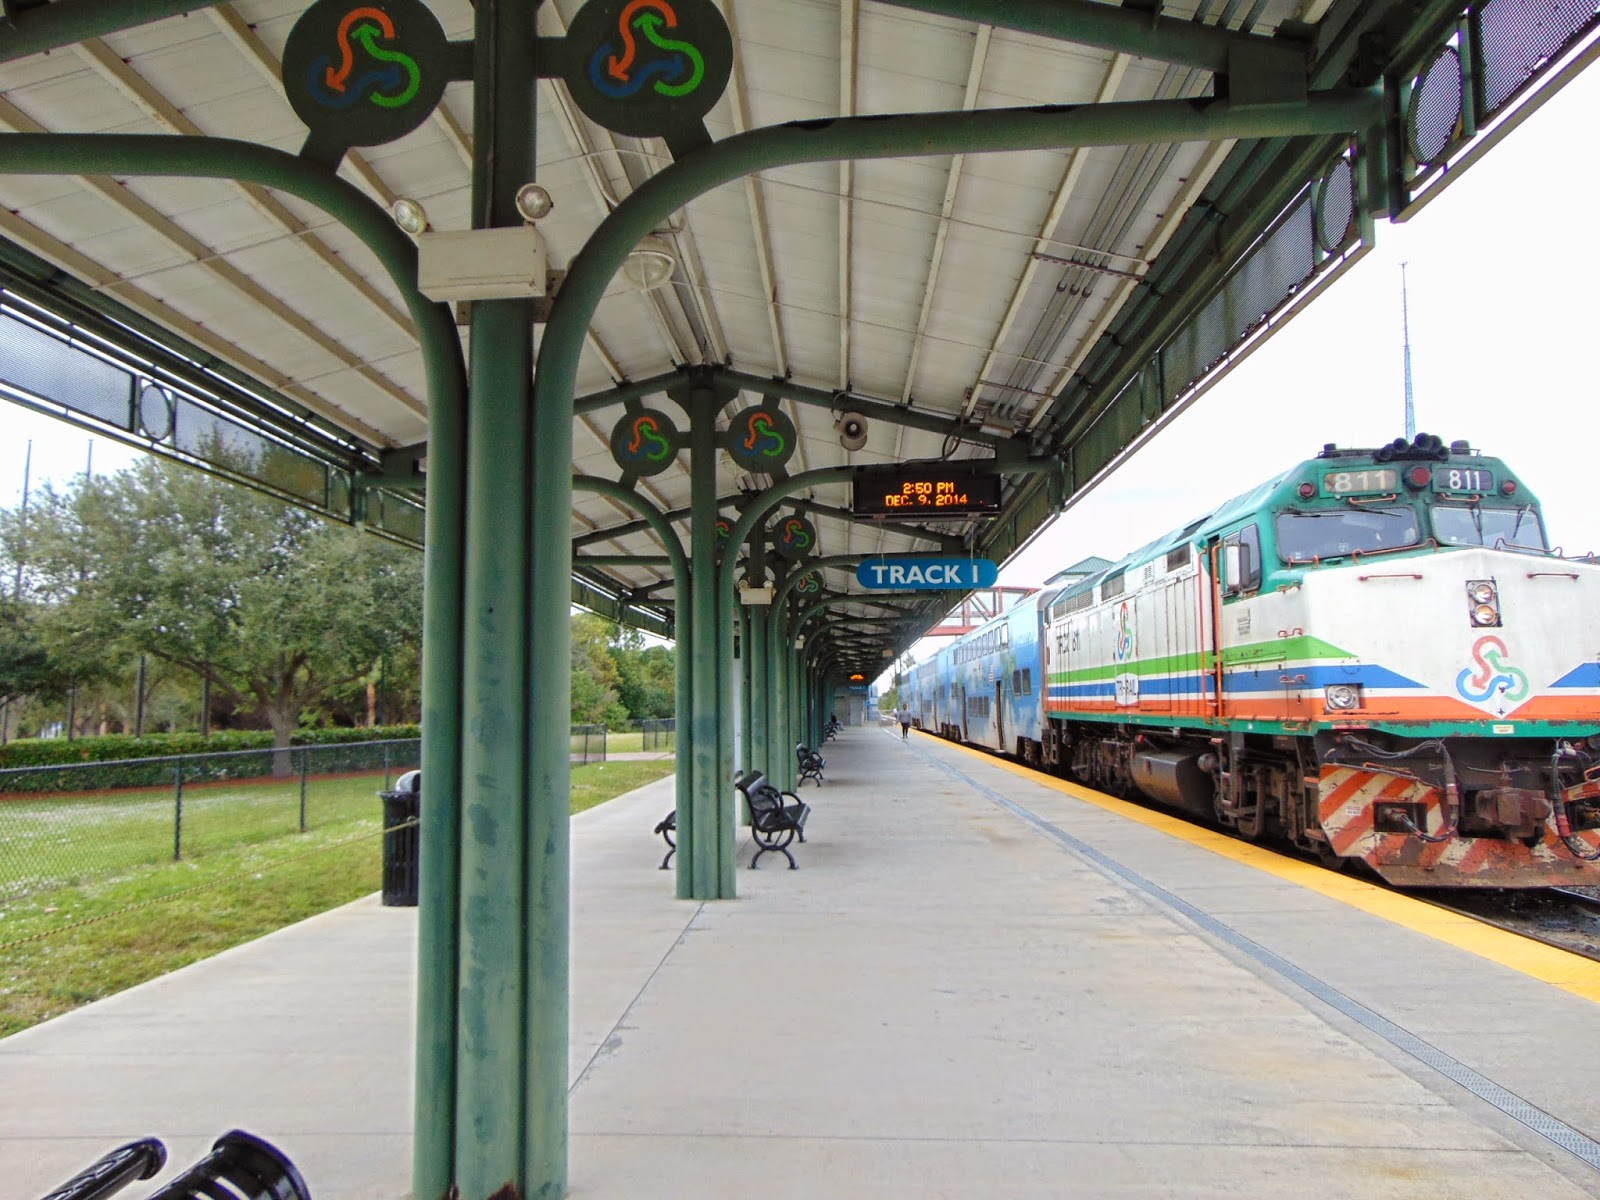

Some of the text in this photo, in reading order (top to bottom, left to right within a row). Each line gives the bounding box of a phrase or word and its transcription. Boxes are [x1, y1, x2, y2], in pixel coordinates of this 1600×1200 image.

[903, 482, 954, 494] 2:50 PM
[1334, 470, 1386, 492] 811
[1449, 469, 1480, 490] 811
[885, 495, 913, 506] DEC.
[935, 494, 968, 506] 2014
[871, 565, 962, 584] TRACK
